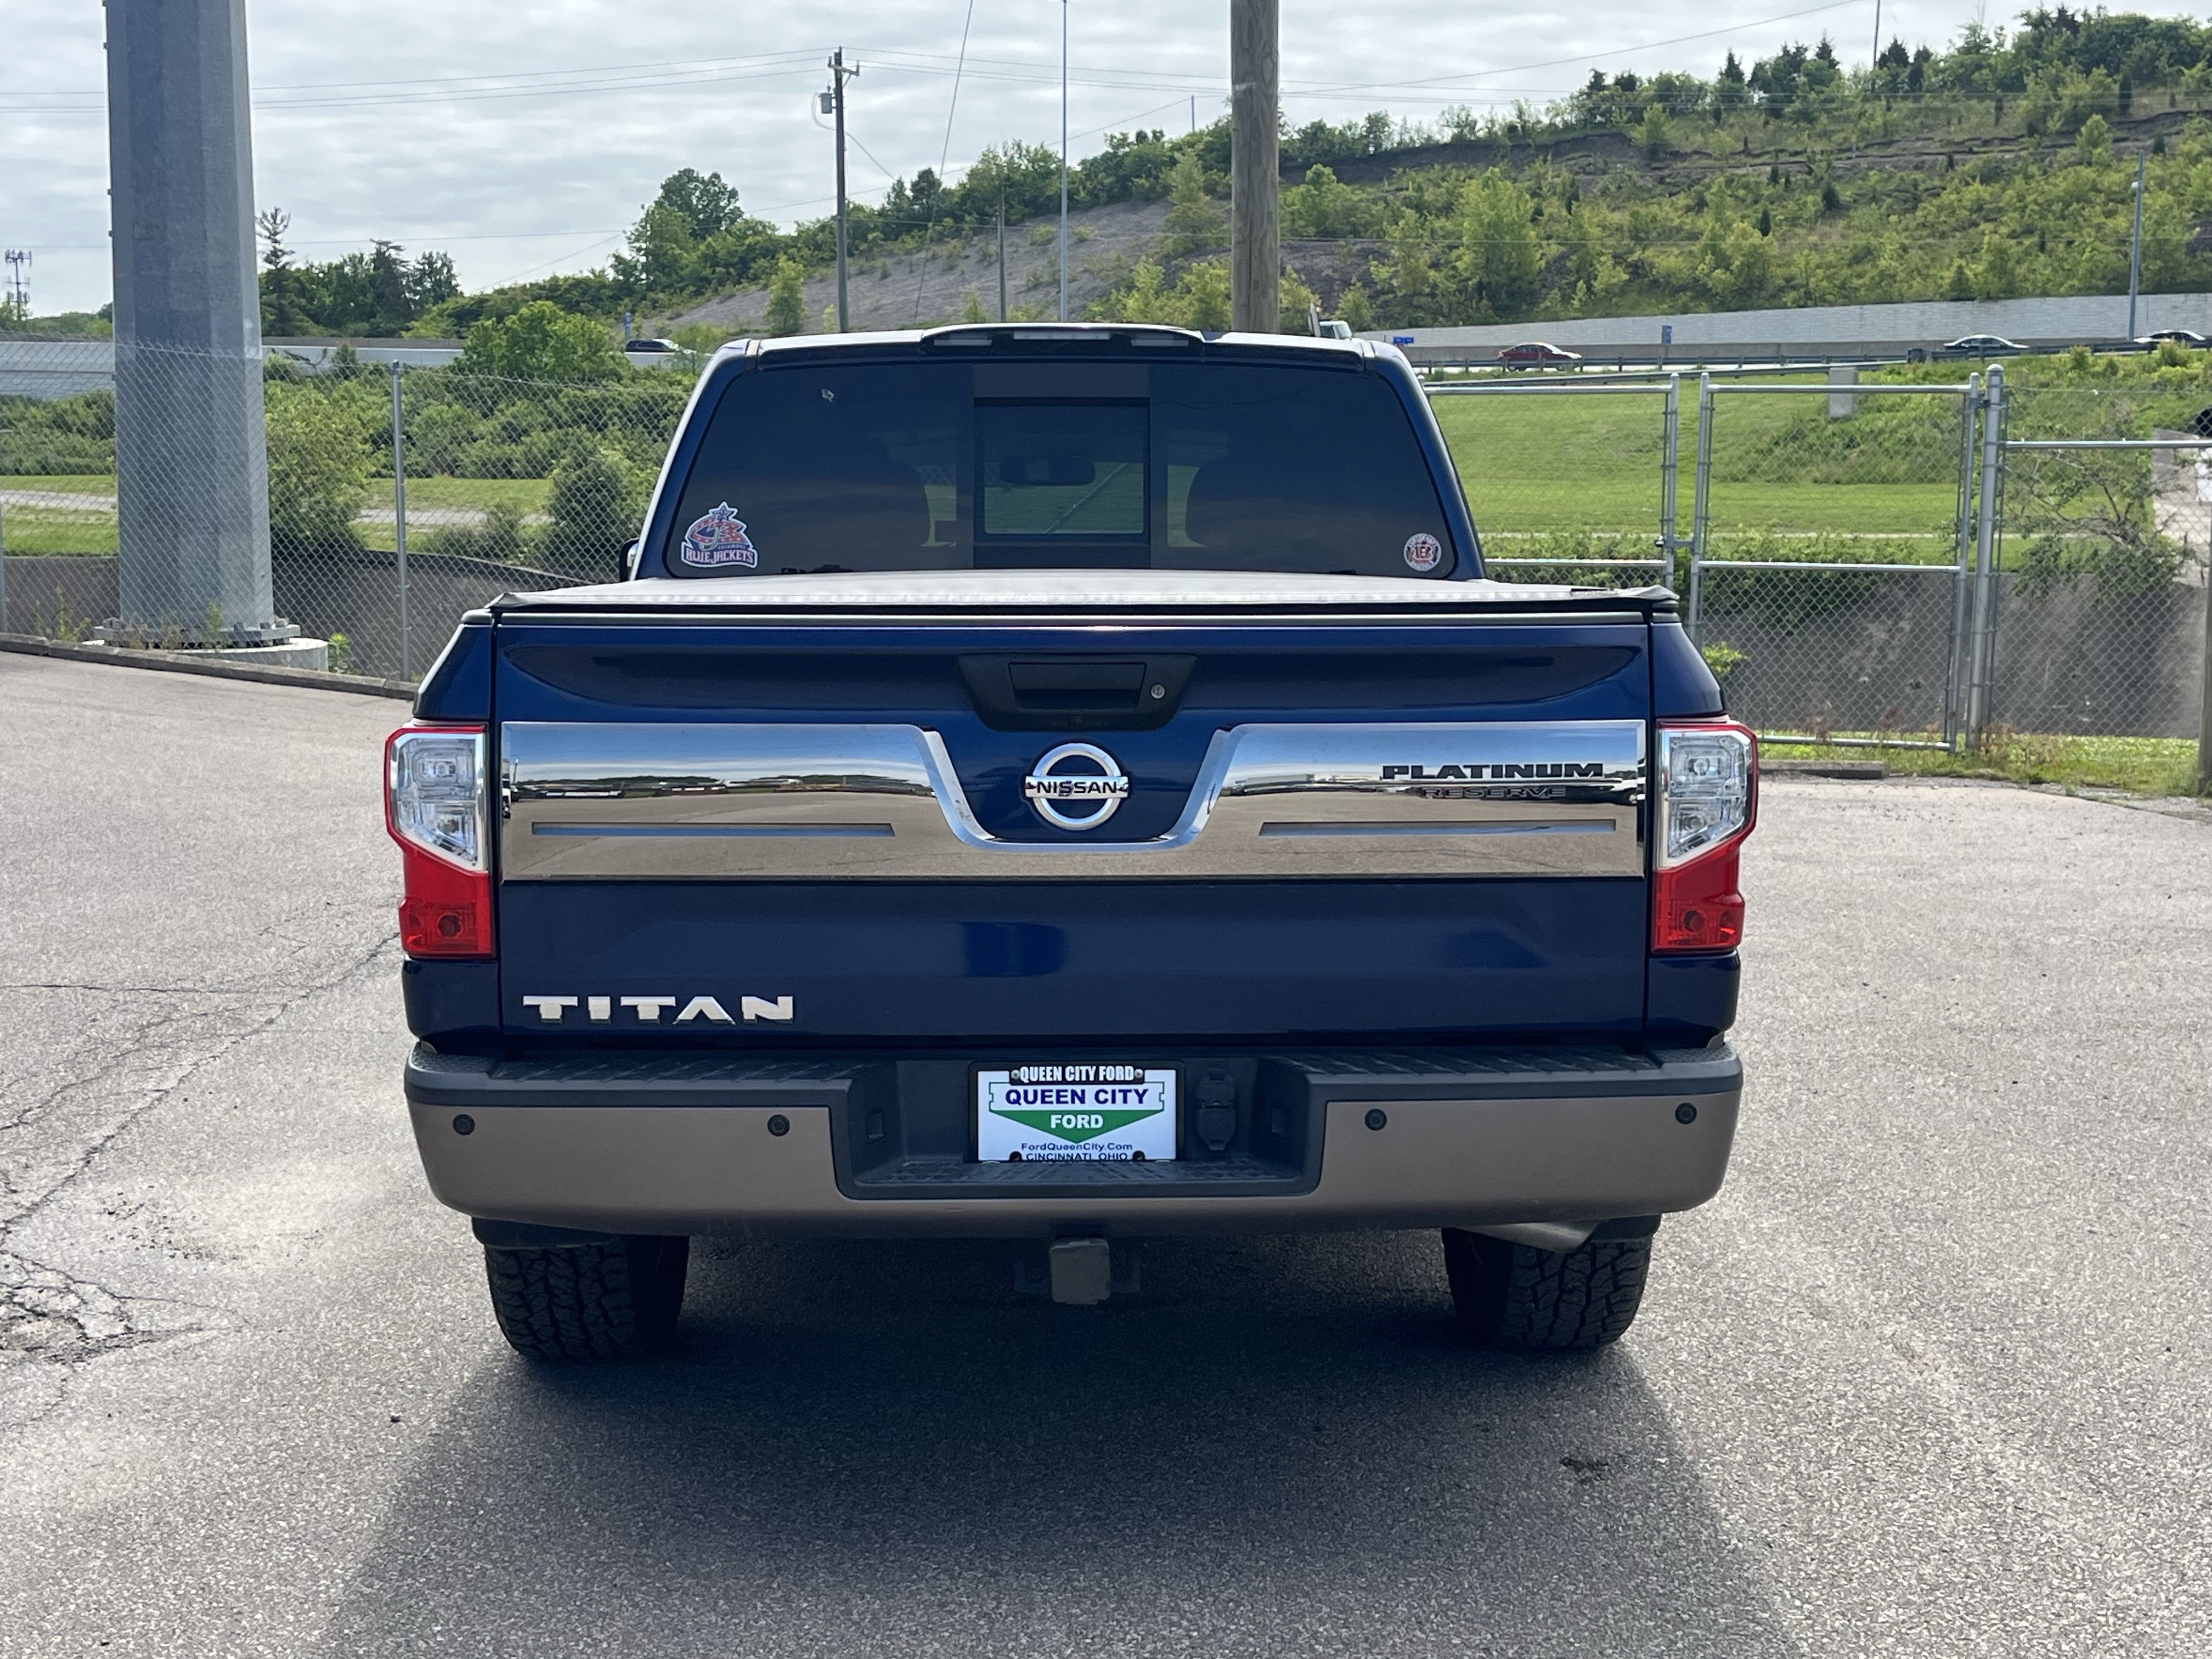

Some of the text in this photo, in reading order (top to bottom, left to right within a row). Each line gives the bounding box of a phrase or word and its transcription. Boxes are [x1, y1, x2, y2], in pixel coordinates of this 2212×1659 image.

[1382, 763, 1604, 780] PLATINUM
[1037, 781, 1117, 793] NISSAN
[1423, 786, 1566, 799] RESERVE
[522, 995, 794, 1025] TITAN
[1019, 1065, 1134, 1084] QUEEN CITY FORD
[1005, 1088, 1149, 1105] QUEEN CITY
[1050, 1114, 1103, 1129] FORD
[1021, 1142, 1133, 1152] FordQueenCity.Com
